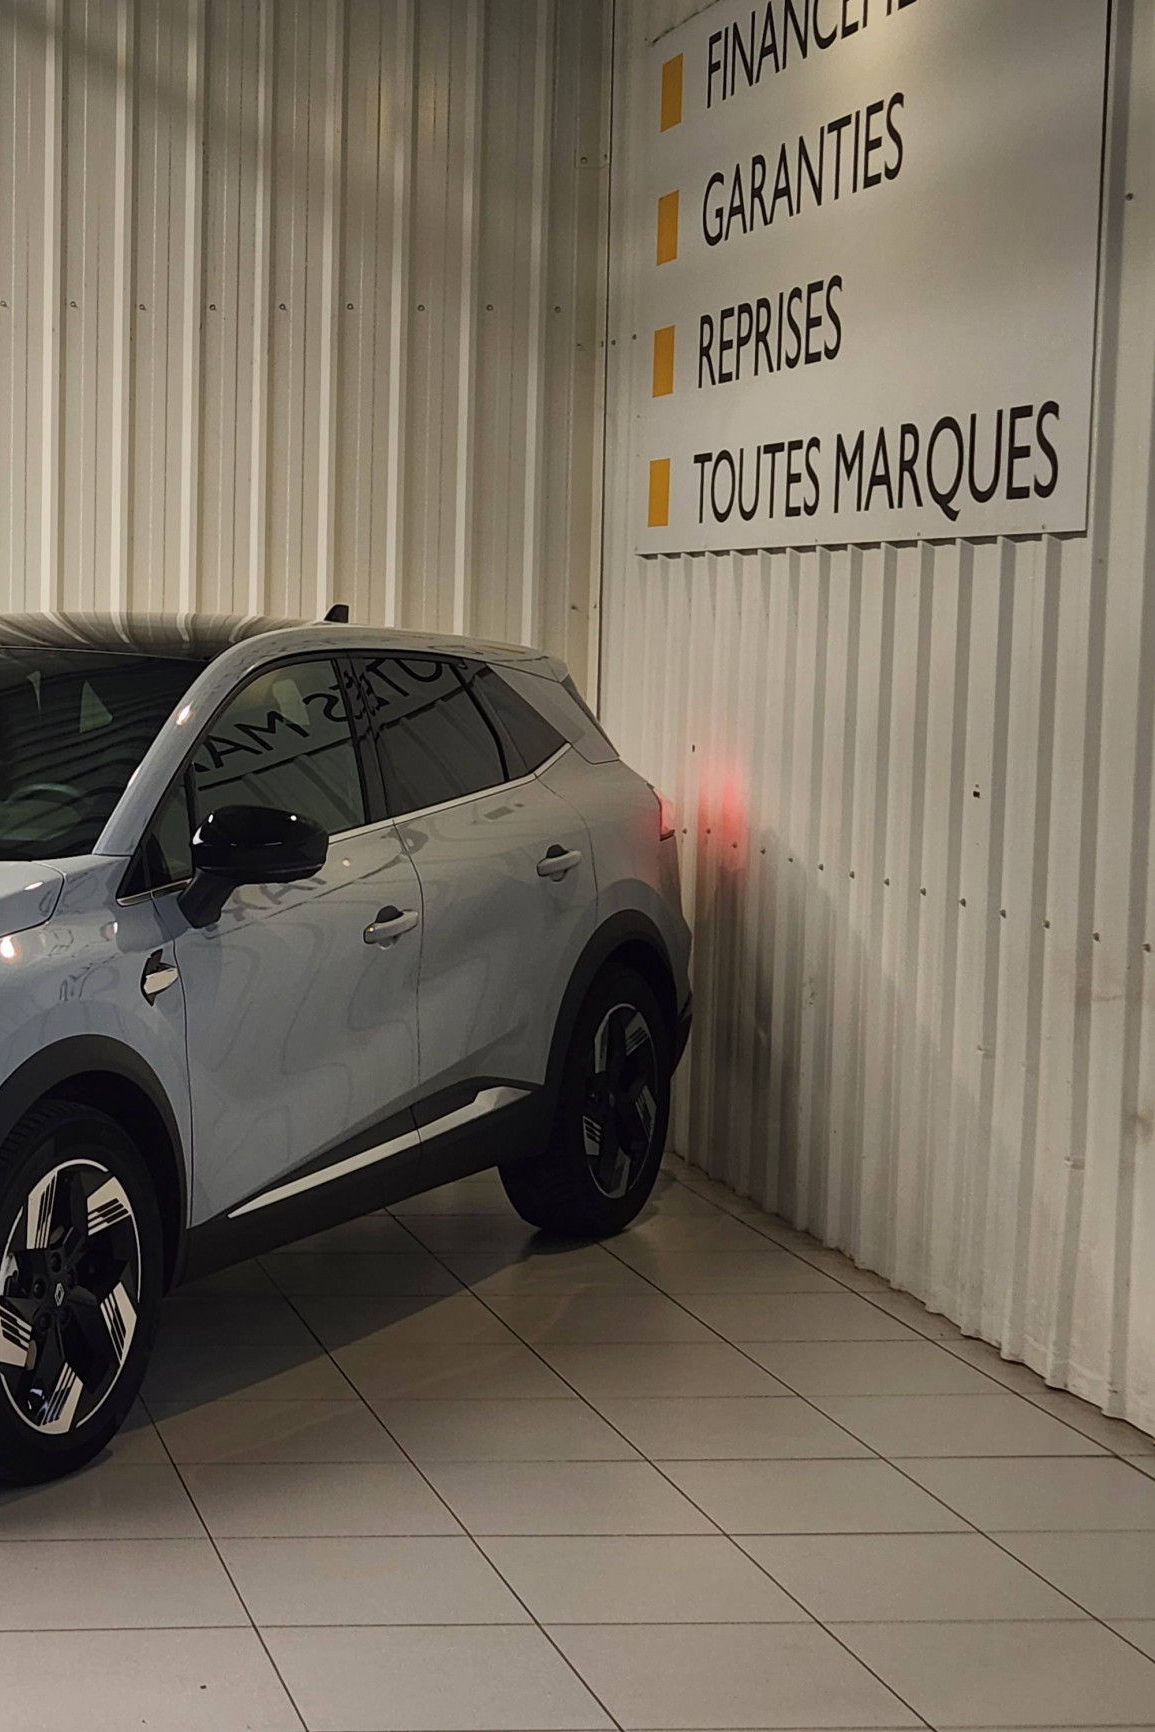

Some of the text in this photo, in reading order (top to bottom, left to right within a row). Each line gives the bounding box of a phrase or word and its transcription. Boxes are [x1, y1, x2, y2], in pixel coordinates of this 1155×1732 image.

[702, 91, 905, 247] GARANTIES
[697, 274, 843, 390] REPRISES
[693, 399, 1061, 524] TOUTES MARQUES
